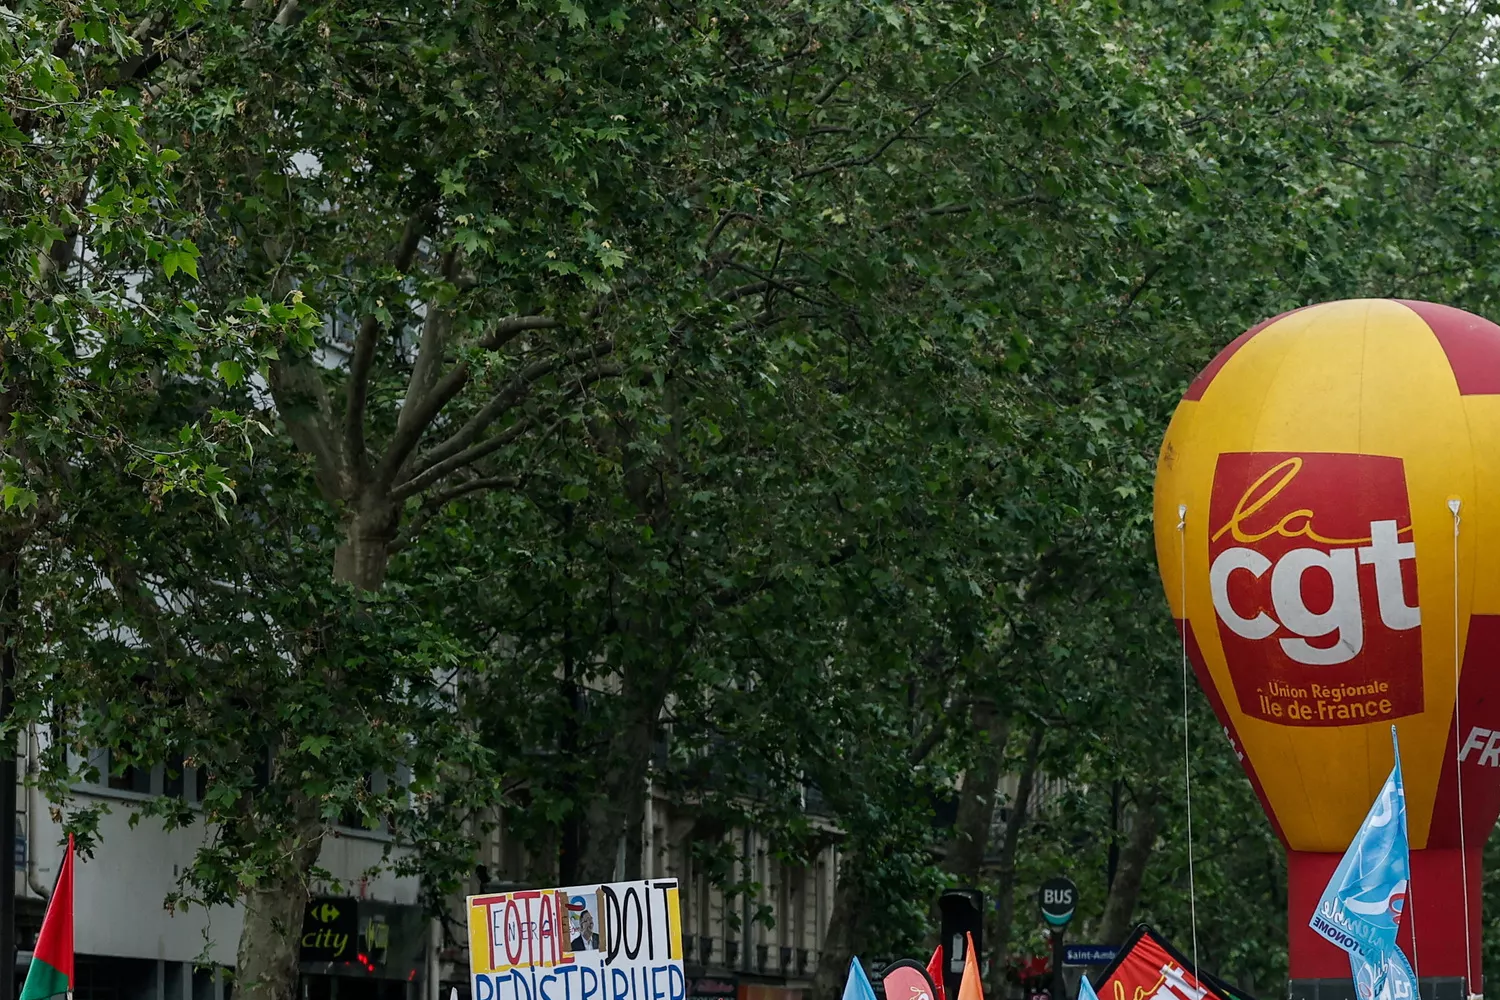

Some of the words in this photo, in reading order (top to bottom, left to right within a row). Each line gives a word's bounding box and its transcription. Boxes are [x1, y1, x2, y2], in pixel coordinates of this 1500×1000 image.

[1210, 456, 1375, 544] la
[1209, 519, 1421, 665] cgt
[1268, 681, 1308, 699] Union
[1311, 681, 1389, 702] Régionale
[1043, 888, 1073, 905] BUS
[302, 927, 348, 958] city
[472, 889, 575, 971] TOTAL
